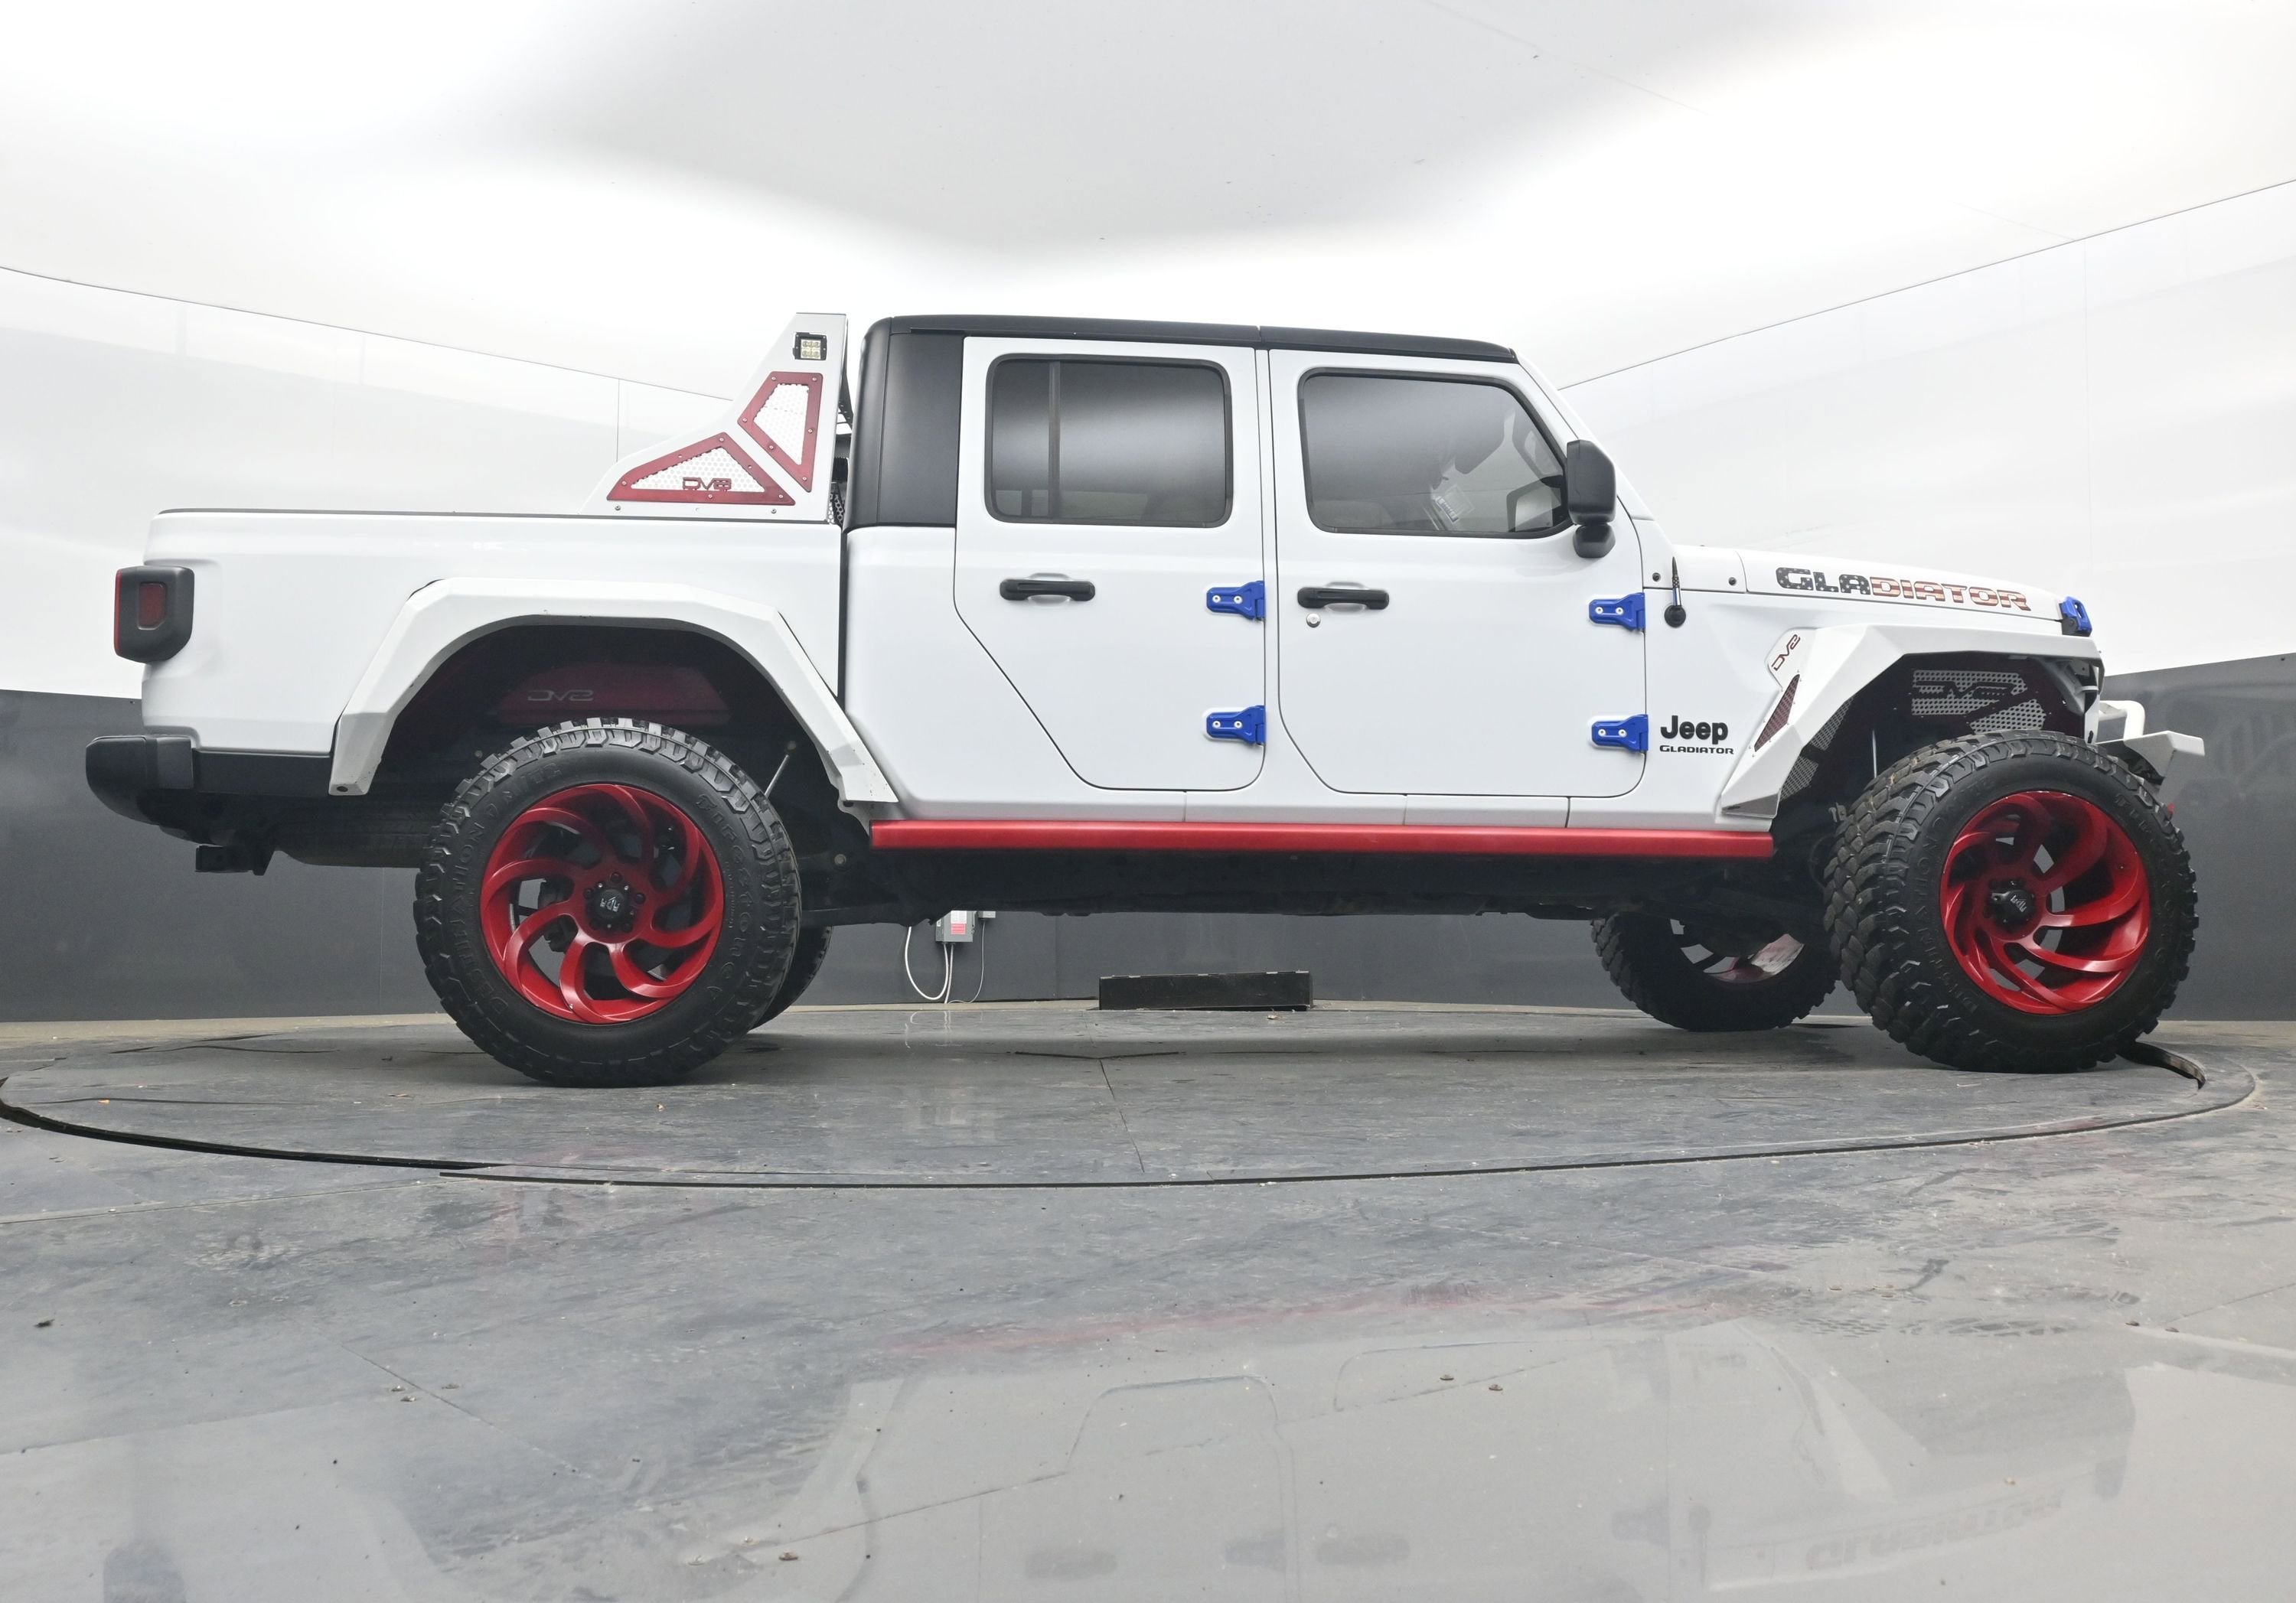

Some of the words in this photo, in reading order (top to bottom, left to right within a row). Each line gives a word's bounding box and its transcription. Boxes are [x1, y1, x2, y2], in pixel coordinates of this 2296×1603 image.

[1776, 567, 2032, 611] GLADIATOR
[1660, 715, 1729, 745] Jeep
[1659, 744, 1734, 754] GLADIATOR
